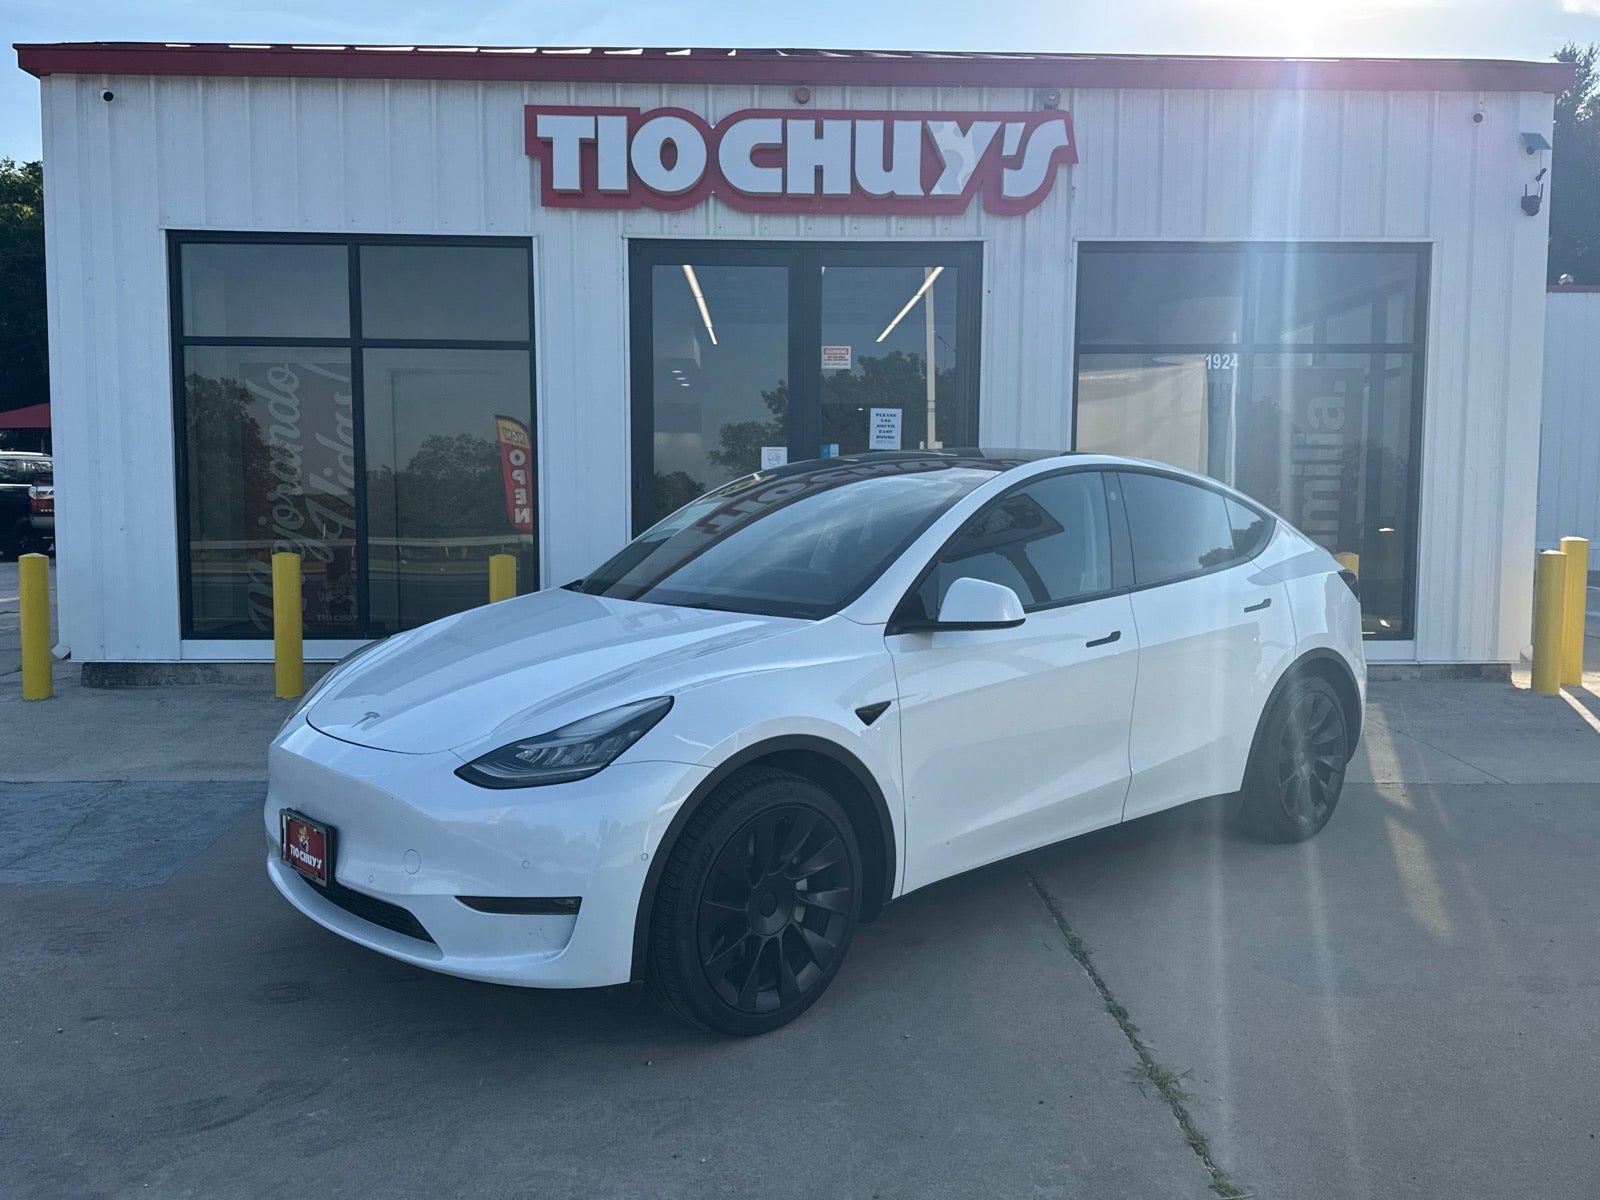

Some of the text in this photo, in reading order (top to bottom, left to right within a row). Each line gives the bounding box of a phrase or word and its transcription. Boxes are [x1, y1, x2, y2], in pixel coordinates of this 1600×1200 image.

[536, 113, 1070, 198] TIO CHUY'S
[1205, 353, 1239, 370] 1924
[1290, 381, 1346, 549] milia.
[290, 844, 300, 859] TIO
